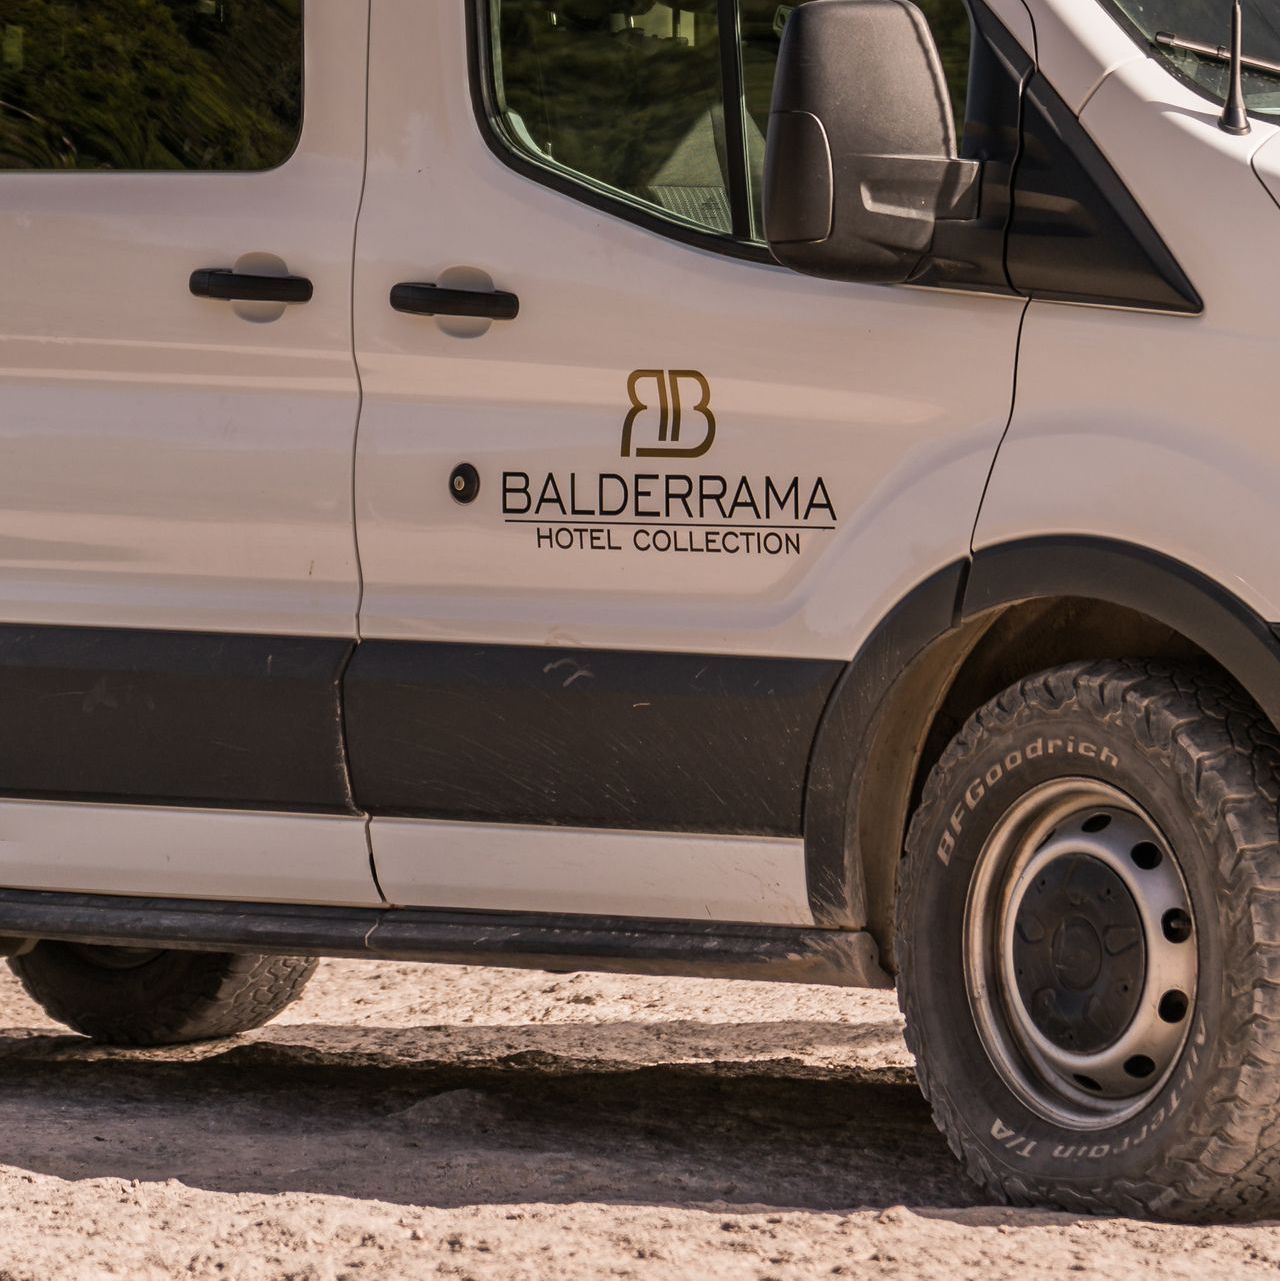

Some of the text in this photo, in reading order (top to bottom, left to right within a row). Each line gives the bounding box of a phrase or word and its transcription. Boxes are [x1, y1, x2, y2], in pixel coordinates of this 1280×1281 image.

[501, 471, 838, 521] BALDERRAMA
[536, 527, 801, 555] HOTEL COLLECTION
[937, 736, 1121, 867] BFGoodrich
